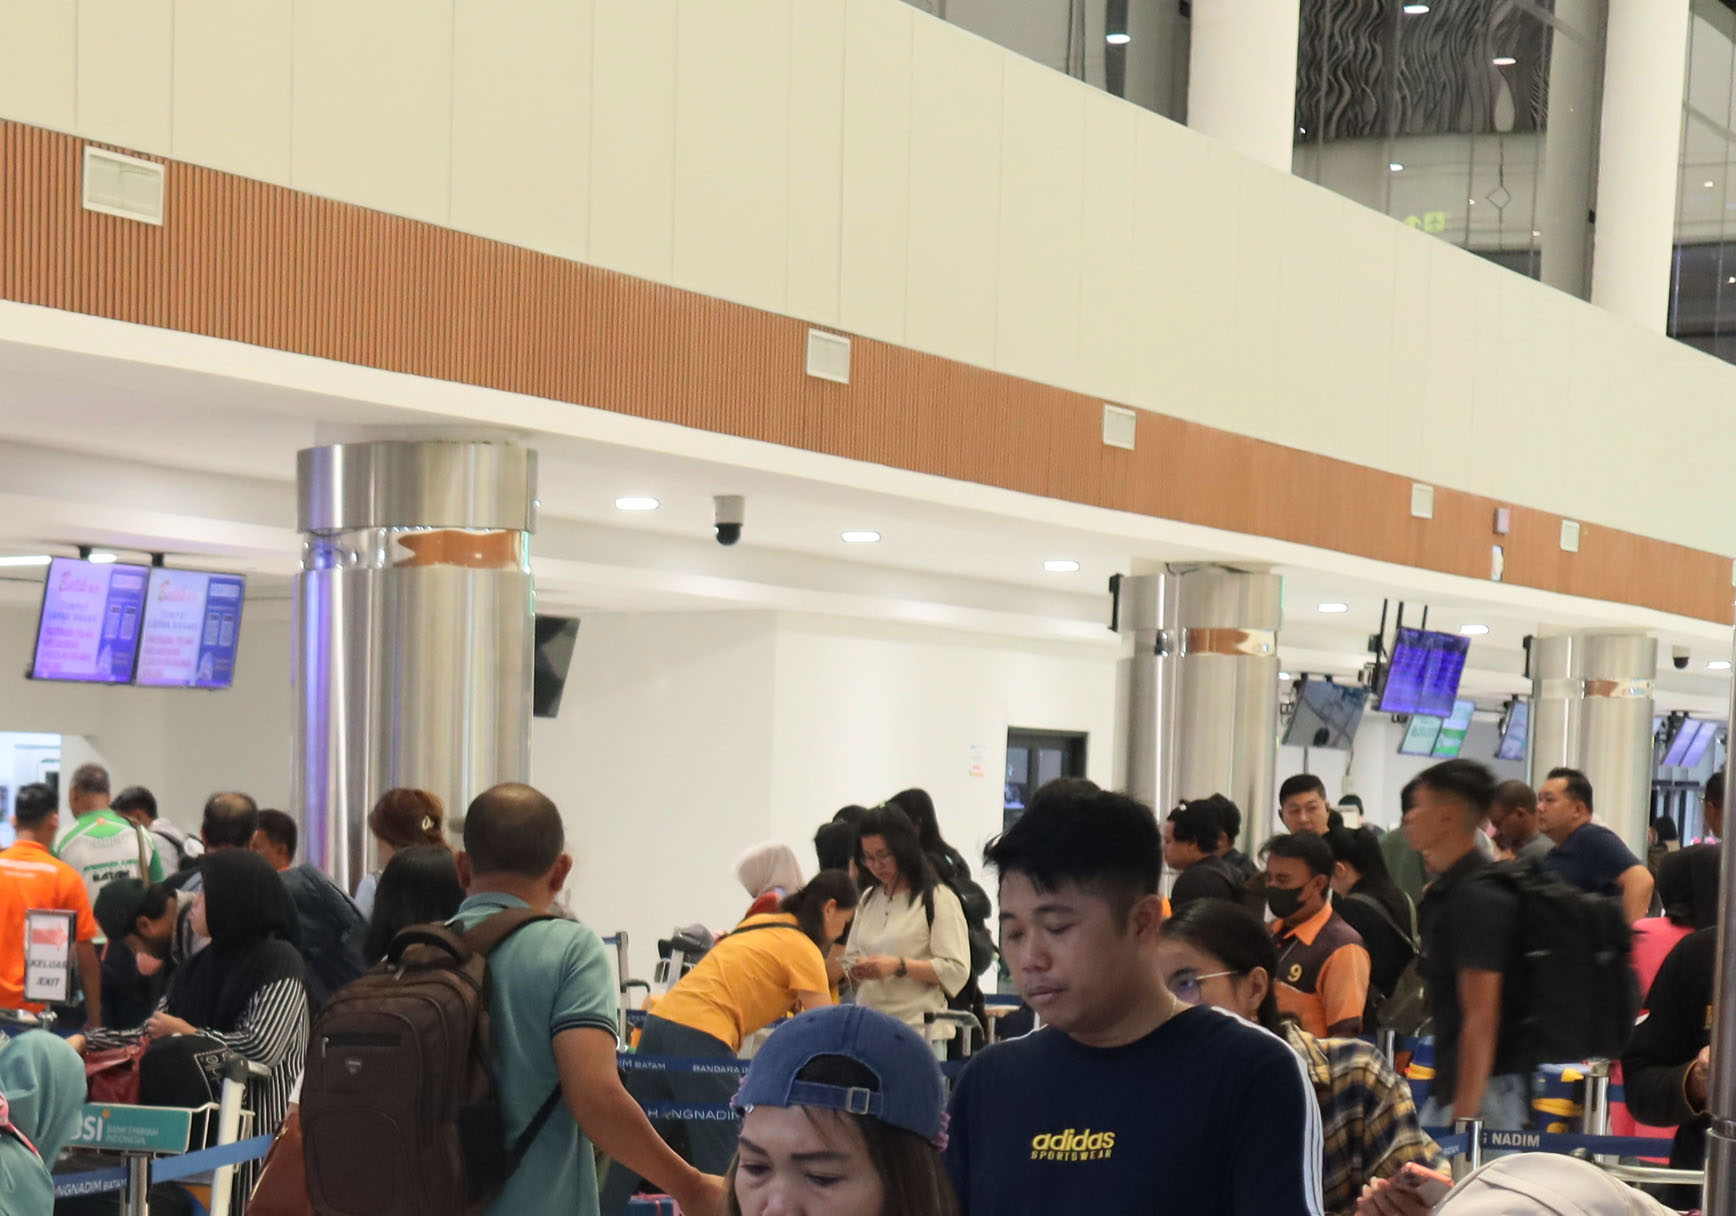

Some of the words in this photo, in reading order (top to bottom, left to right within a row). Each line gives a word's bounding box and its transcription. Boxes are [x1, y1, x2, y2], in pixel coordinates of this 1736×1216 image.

[1287, 963, 1302, 983] 9
[635, 1061, 666, 1071] BATAM
[692, 1063, 741, 1074] BANDARA
[1031, 1128, 1116, 1151] adidas
[1491, 1132, 1541, 1148] NADIM
[1031, 1150, 1113, 1161] SPORTSWEAR
[102, 1177, 128, 1191] BATAM
